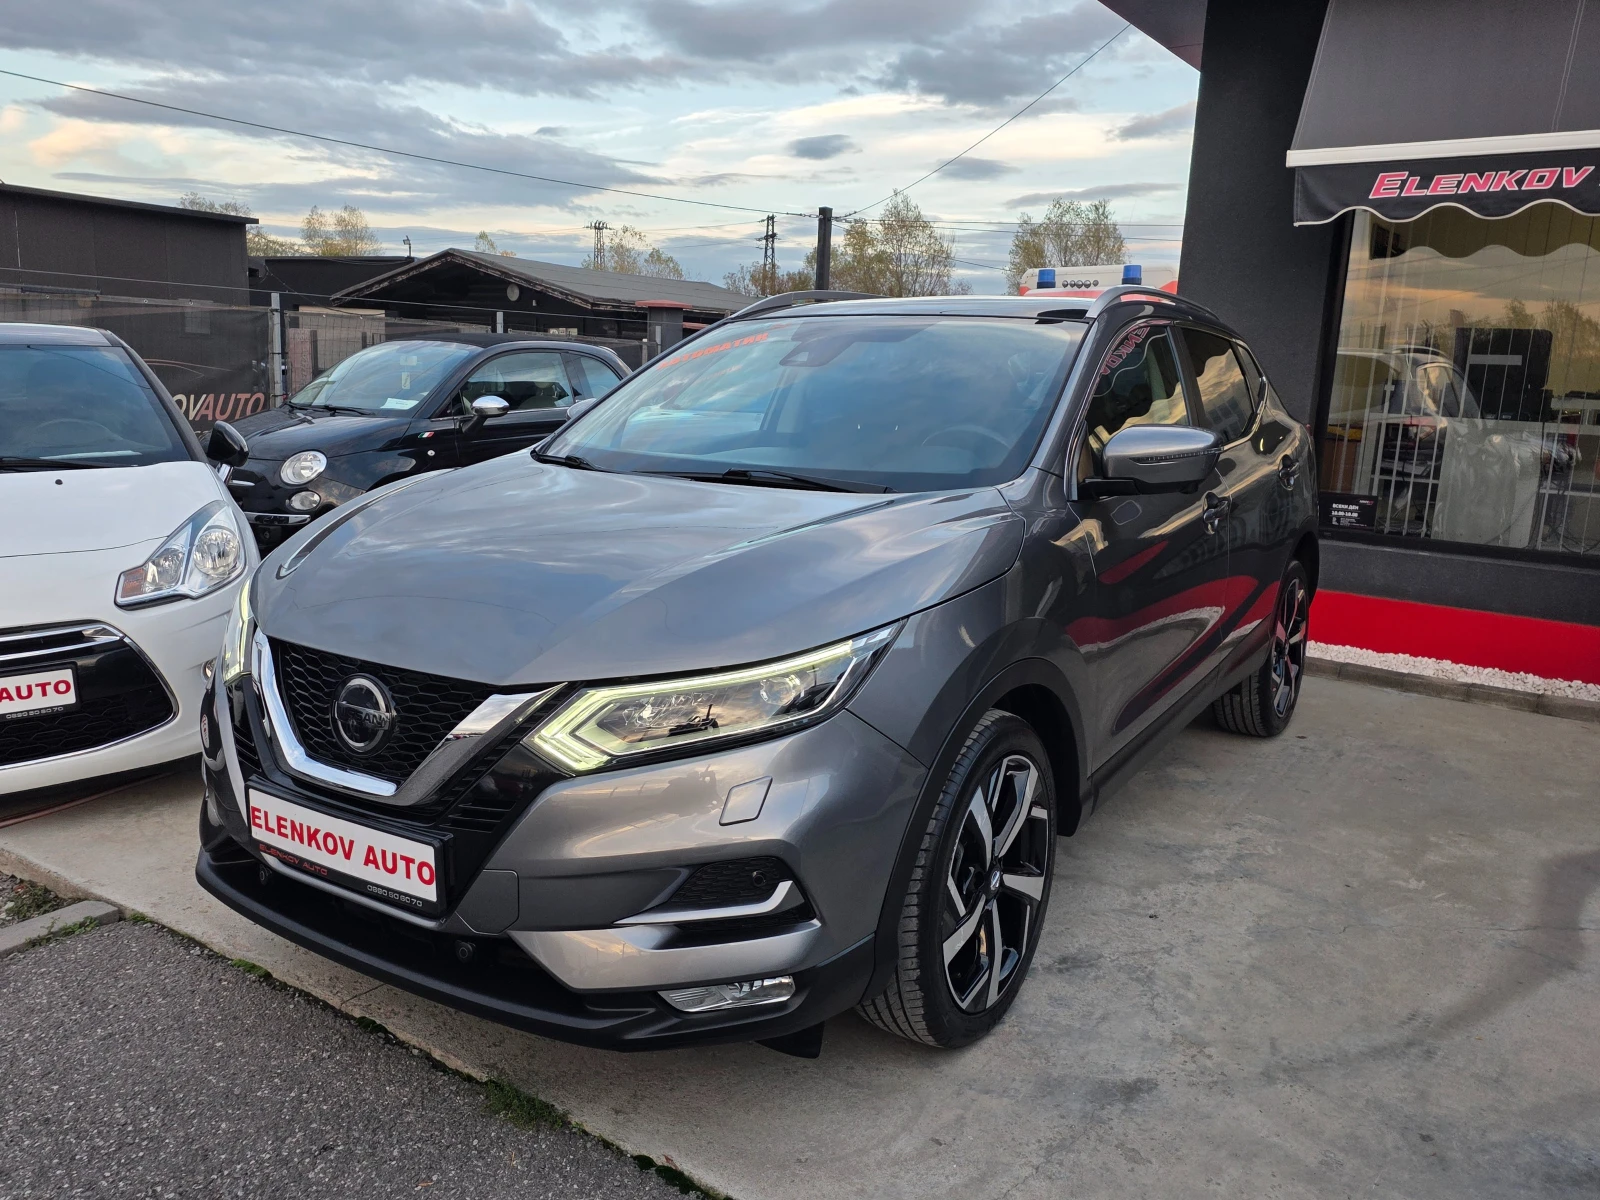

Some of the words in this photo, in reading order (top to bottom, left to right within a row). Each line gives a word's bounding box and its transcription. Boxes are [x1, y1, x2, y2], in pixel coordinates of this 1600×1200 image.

[1369, 166, 1595, 199] ELENKOV
[0, 679, 72, 702] AUTO
[250, 805, 355, 861] ELENKOV
[363, 845, 436, 886] AUTO
[259, 843, 300, 864] ELENKOV
[303, 861, 328, 876] AUTO
[411, 898, 423, 907] 70
